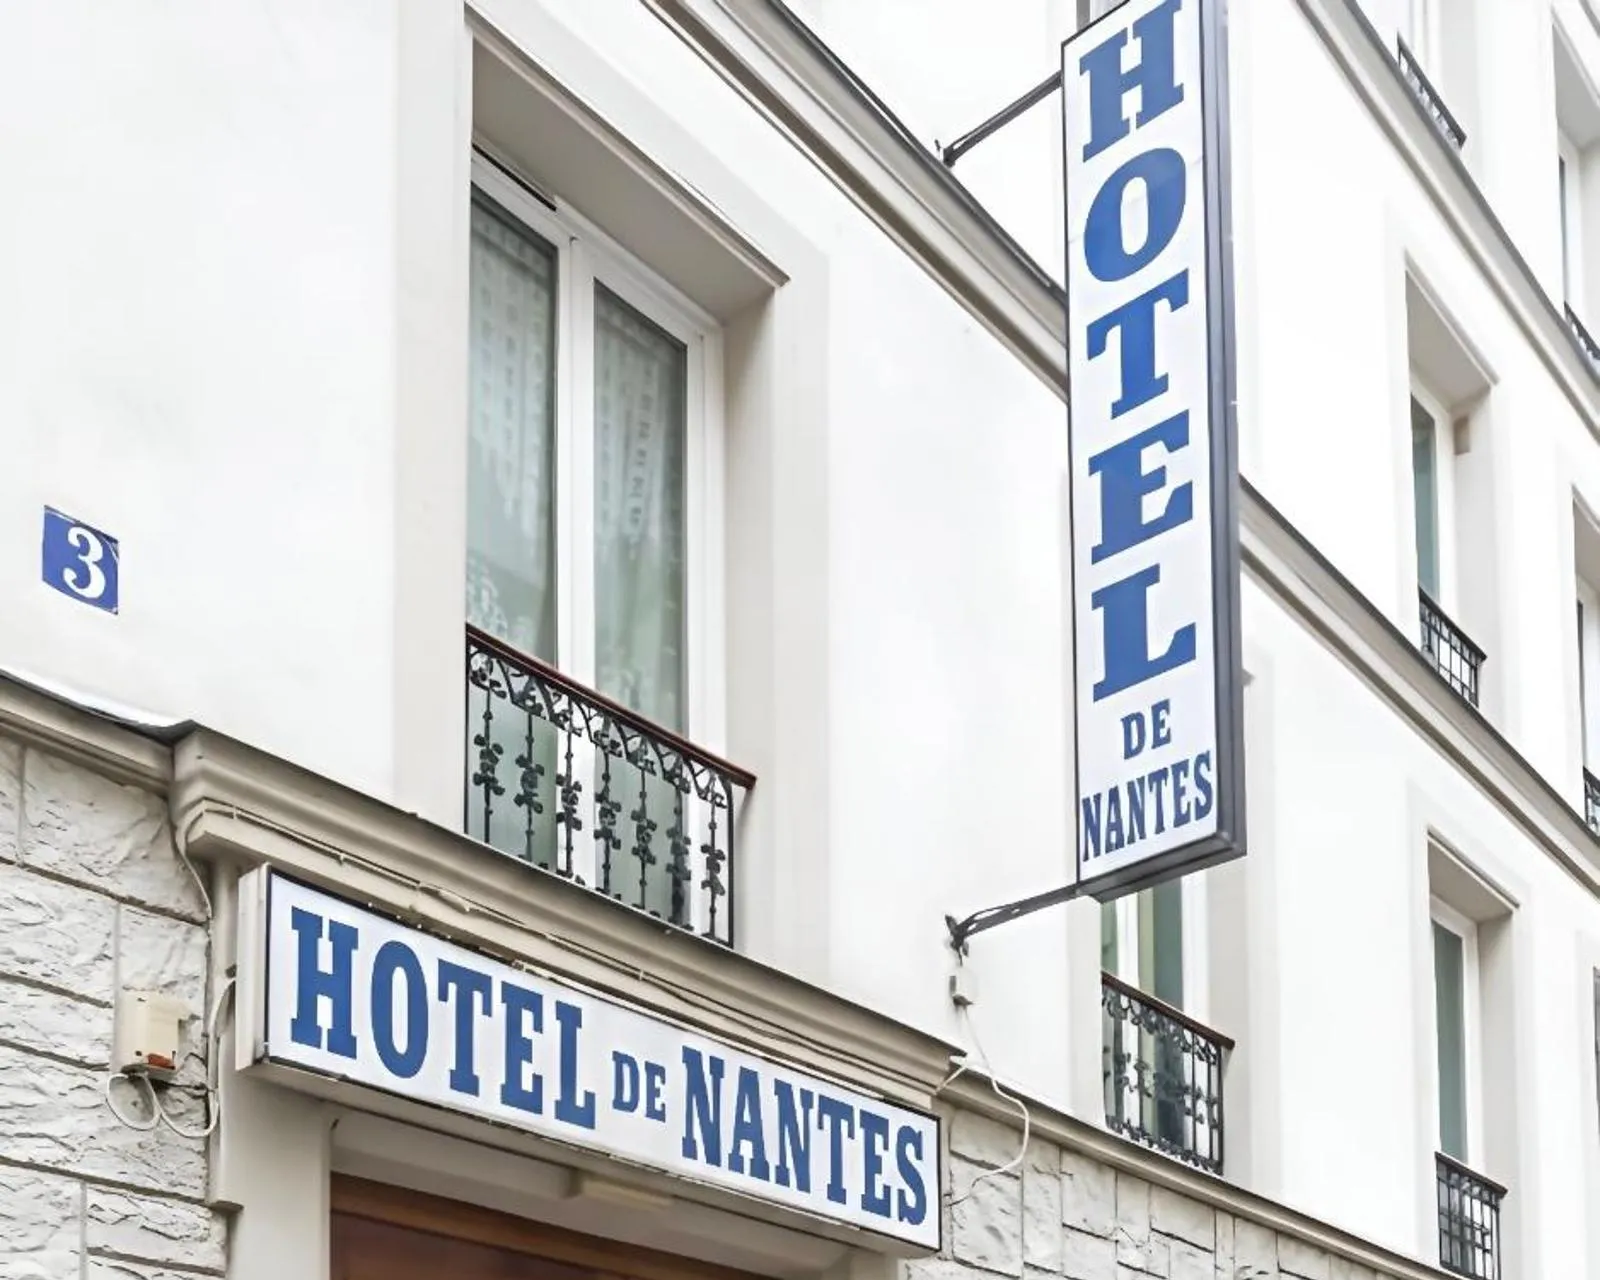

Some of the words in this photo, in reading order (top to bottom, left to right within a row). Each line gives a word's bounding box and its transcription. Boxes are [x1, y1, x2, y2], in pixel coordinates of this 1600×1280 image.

[1079, 0, 1197, 703] HOTEL
[63, 526, 106, 599] 3
[1121, 698, 1171, 760] DE
[1081, 749, 1213, 862] NANTES
[290, 905, 596, 1130] HOTEL
[612, 1049, 667, 1123] DE
[681, 1045, 928, 1226] NANTES
